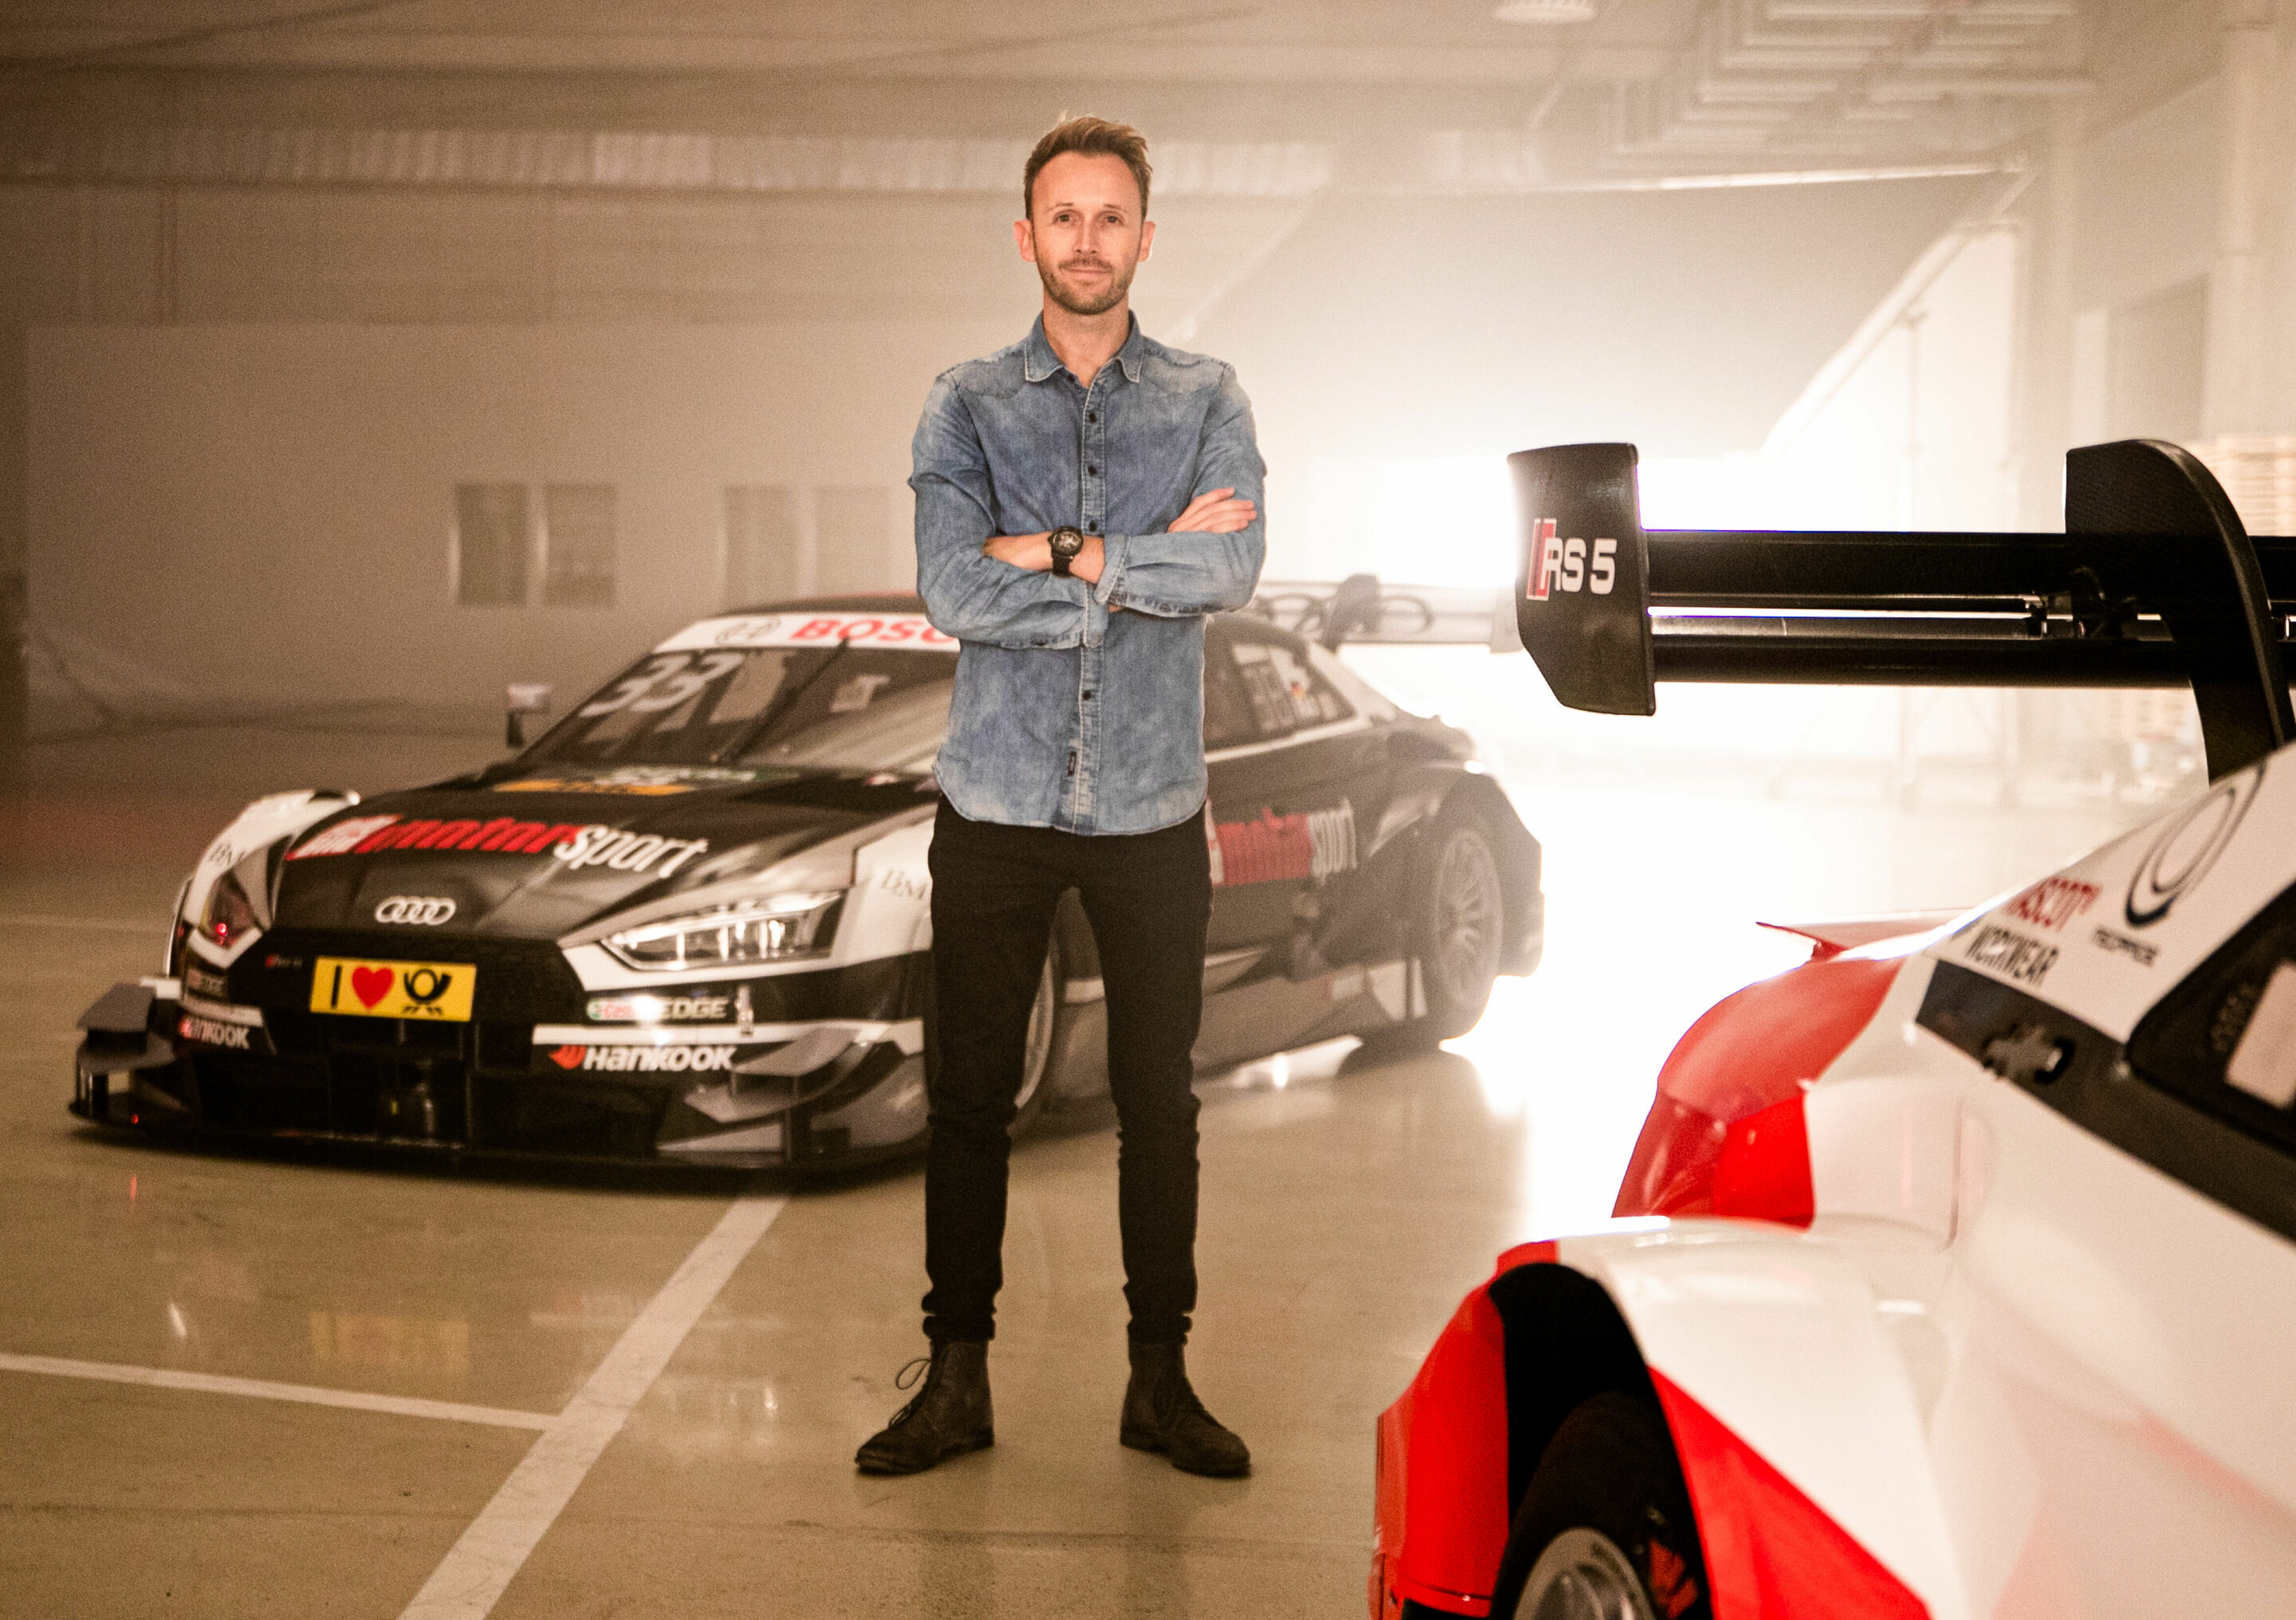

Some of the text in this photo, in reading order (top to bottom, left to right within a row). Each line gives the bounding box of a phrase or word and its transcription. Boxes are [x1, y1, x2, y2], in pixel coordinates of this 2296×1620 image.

[788, 619, 956, 643] BOSC
[580, 651, 746, 717] 33
[554, 824, 708, 878] sport
